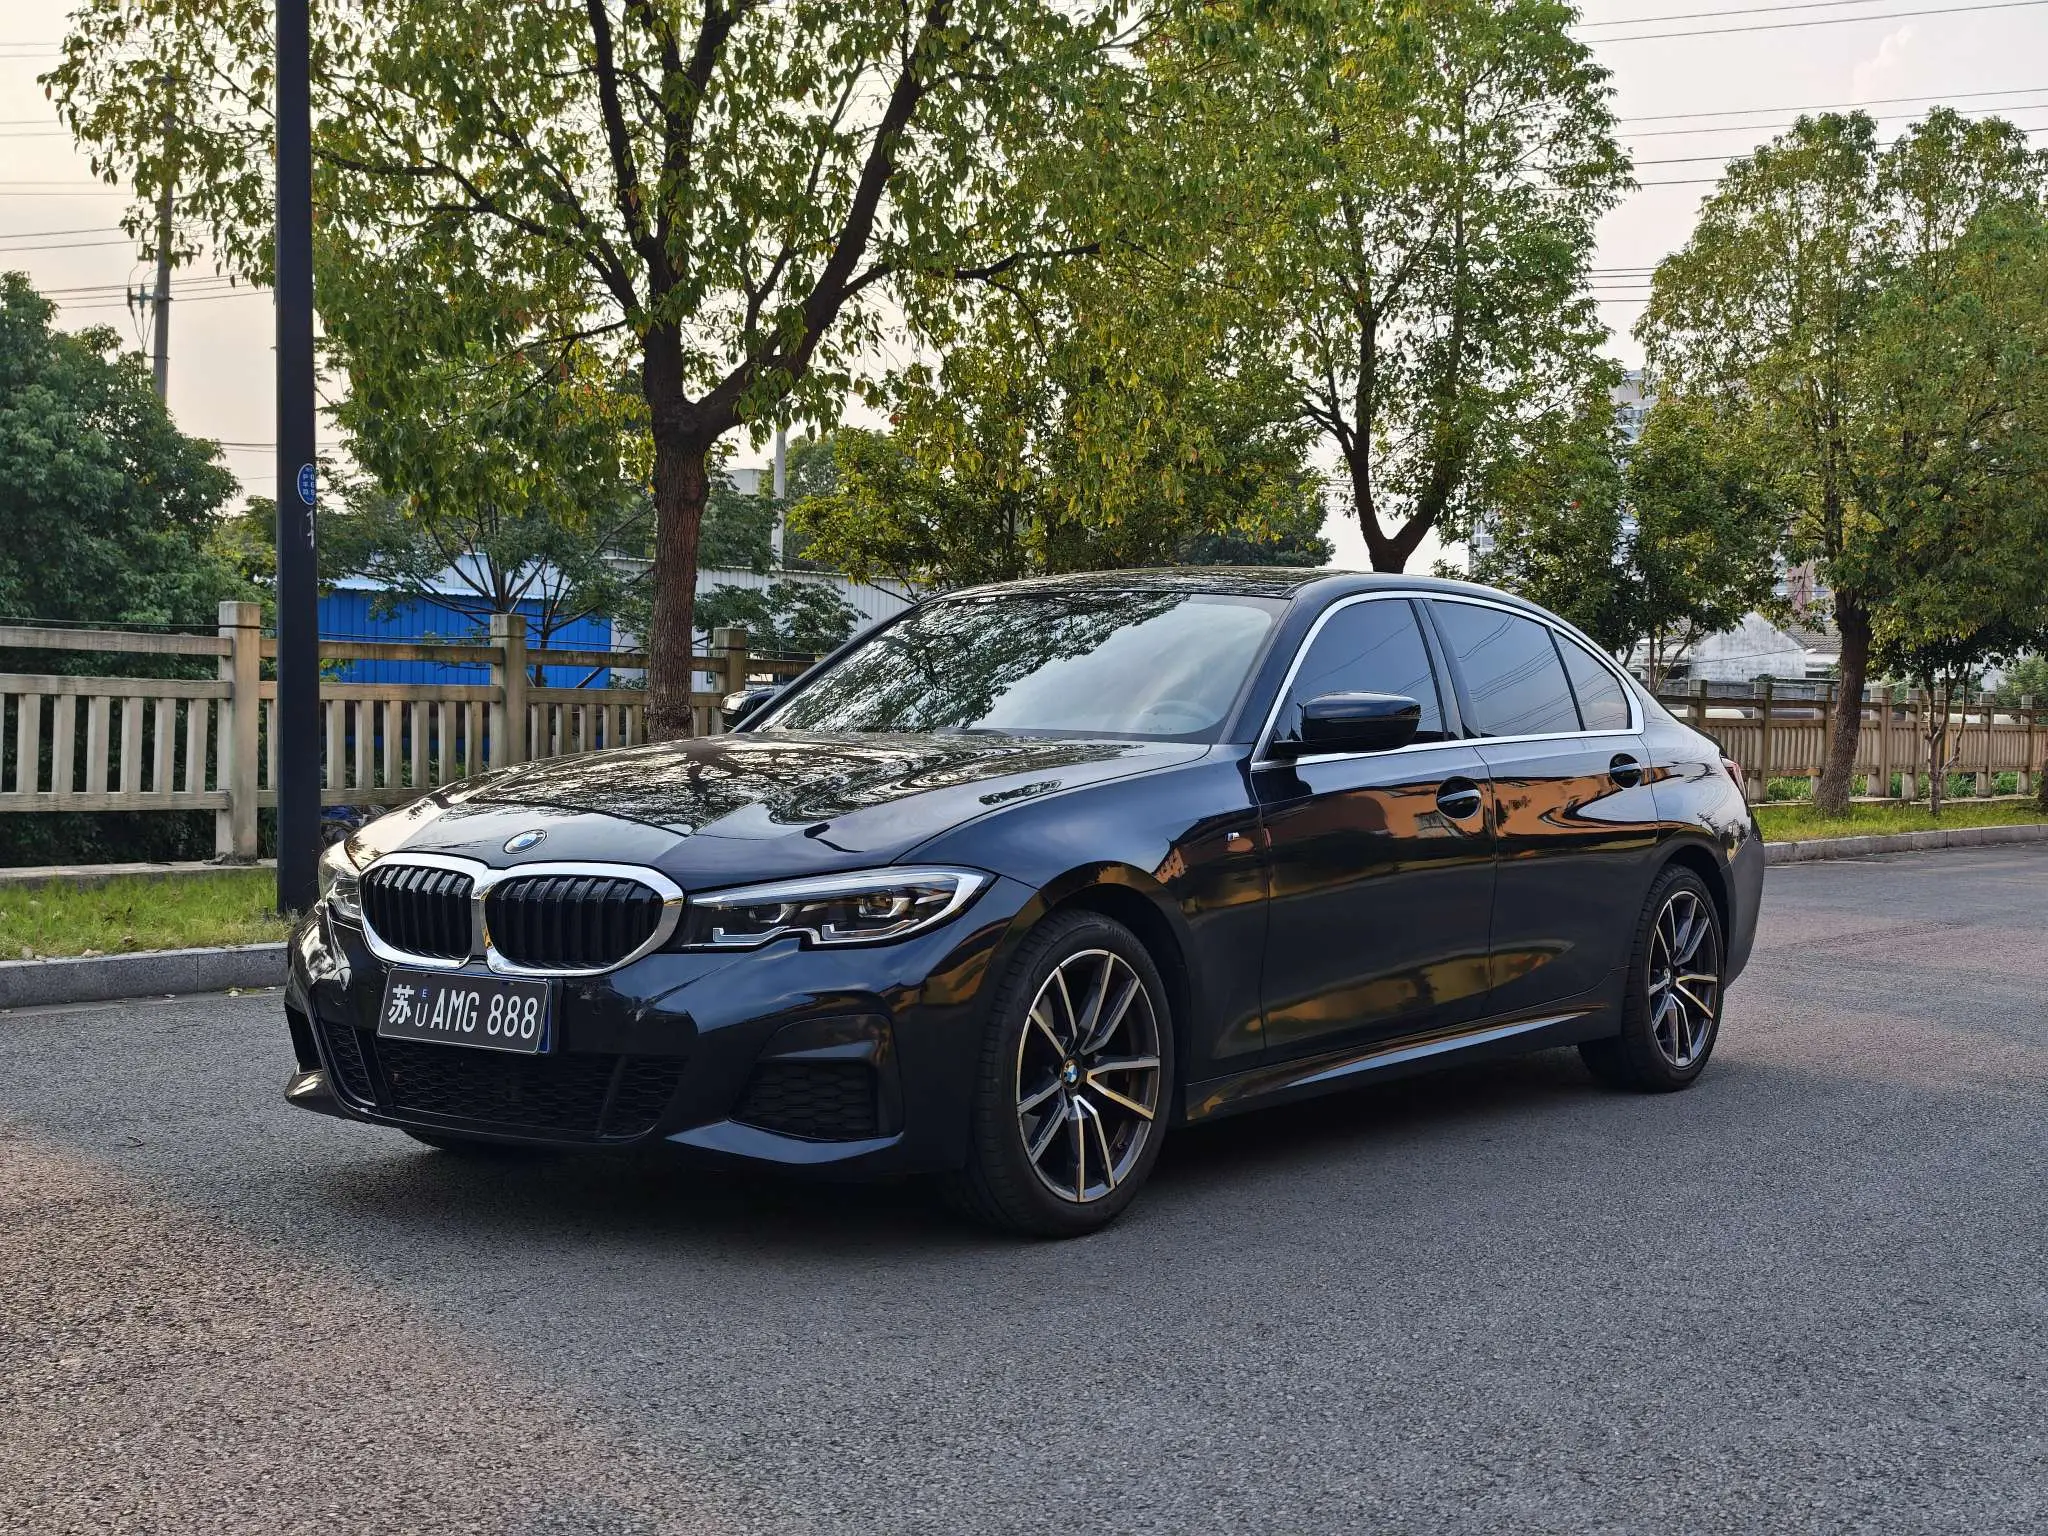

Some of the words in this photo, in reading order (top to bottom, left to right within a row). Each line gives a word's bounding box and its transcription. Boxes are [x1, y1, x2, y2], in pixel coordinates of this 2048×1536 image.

[388, 984, 414, 1024] 苏
[430, 988, 480, 1033] AMG
[487, 993, 538, 1039] 888
